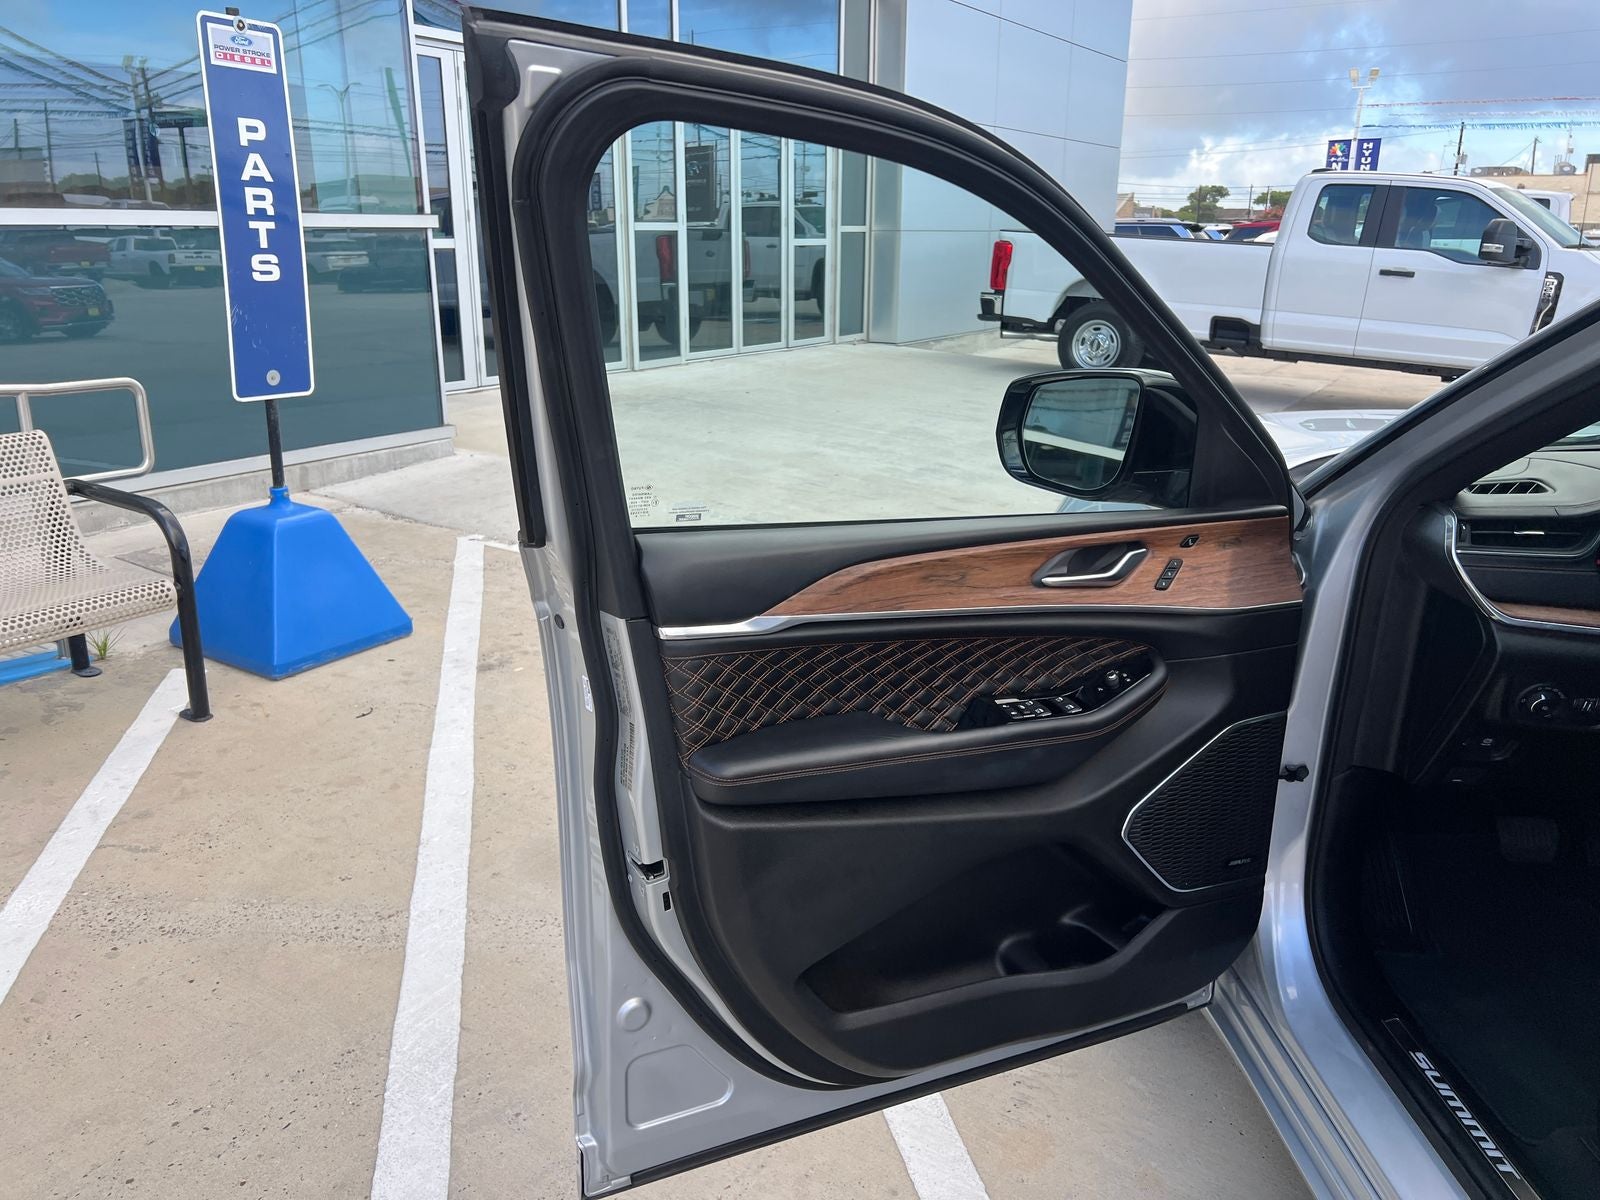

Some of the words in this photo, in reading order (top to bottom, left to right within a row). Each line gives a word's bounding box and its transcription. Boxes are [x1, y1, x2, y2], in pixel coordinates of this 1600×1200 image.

[213, 44, 241, 54] POWER
[242, 48, 271, 58] STROKE
[215, 52, 272, 66] DIESEL
[237, 117, 281, 282] PARTS
[1409, 1051, 1521, 1180] SUMMIT
